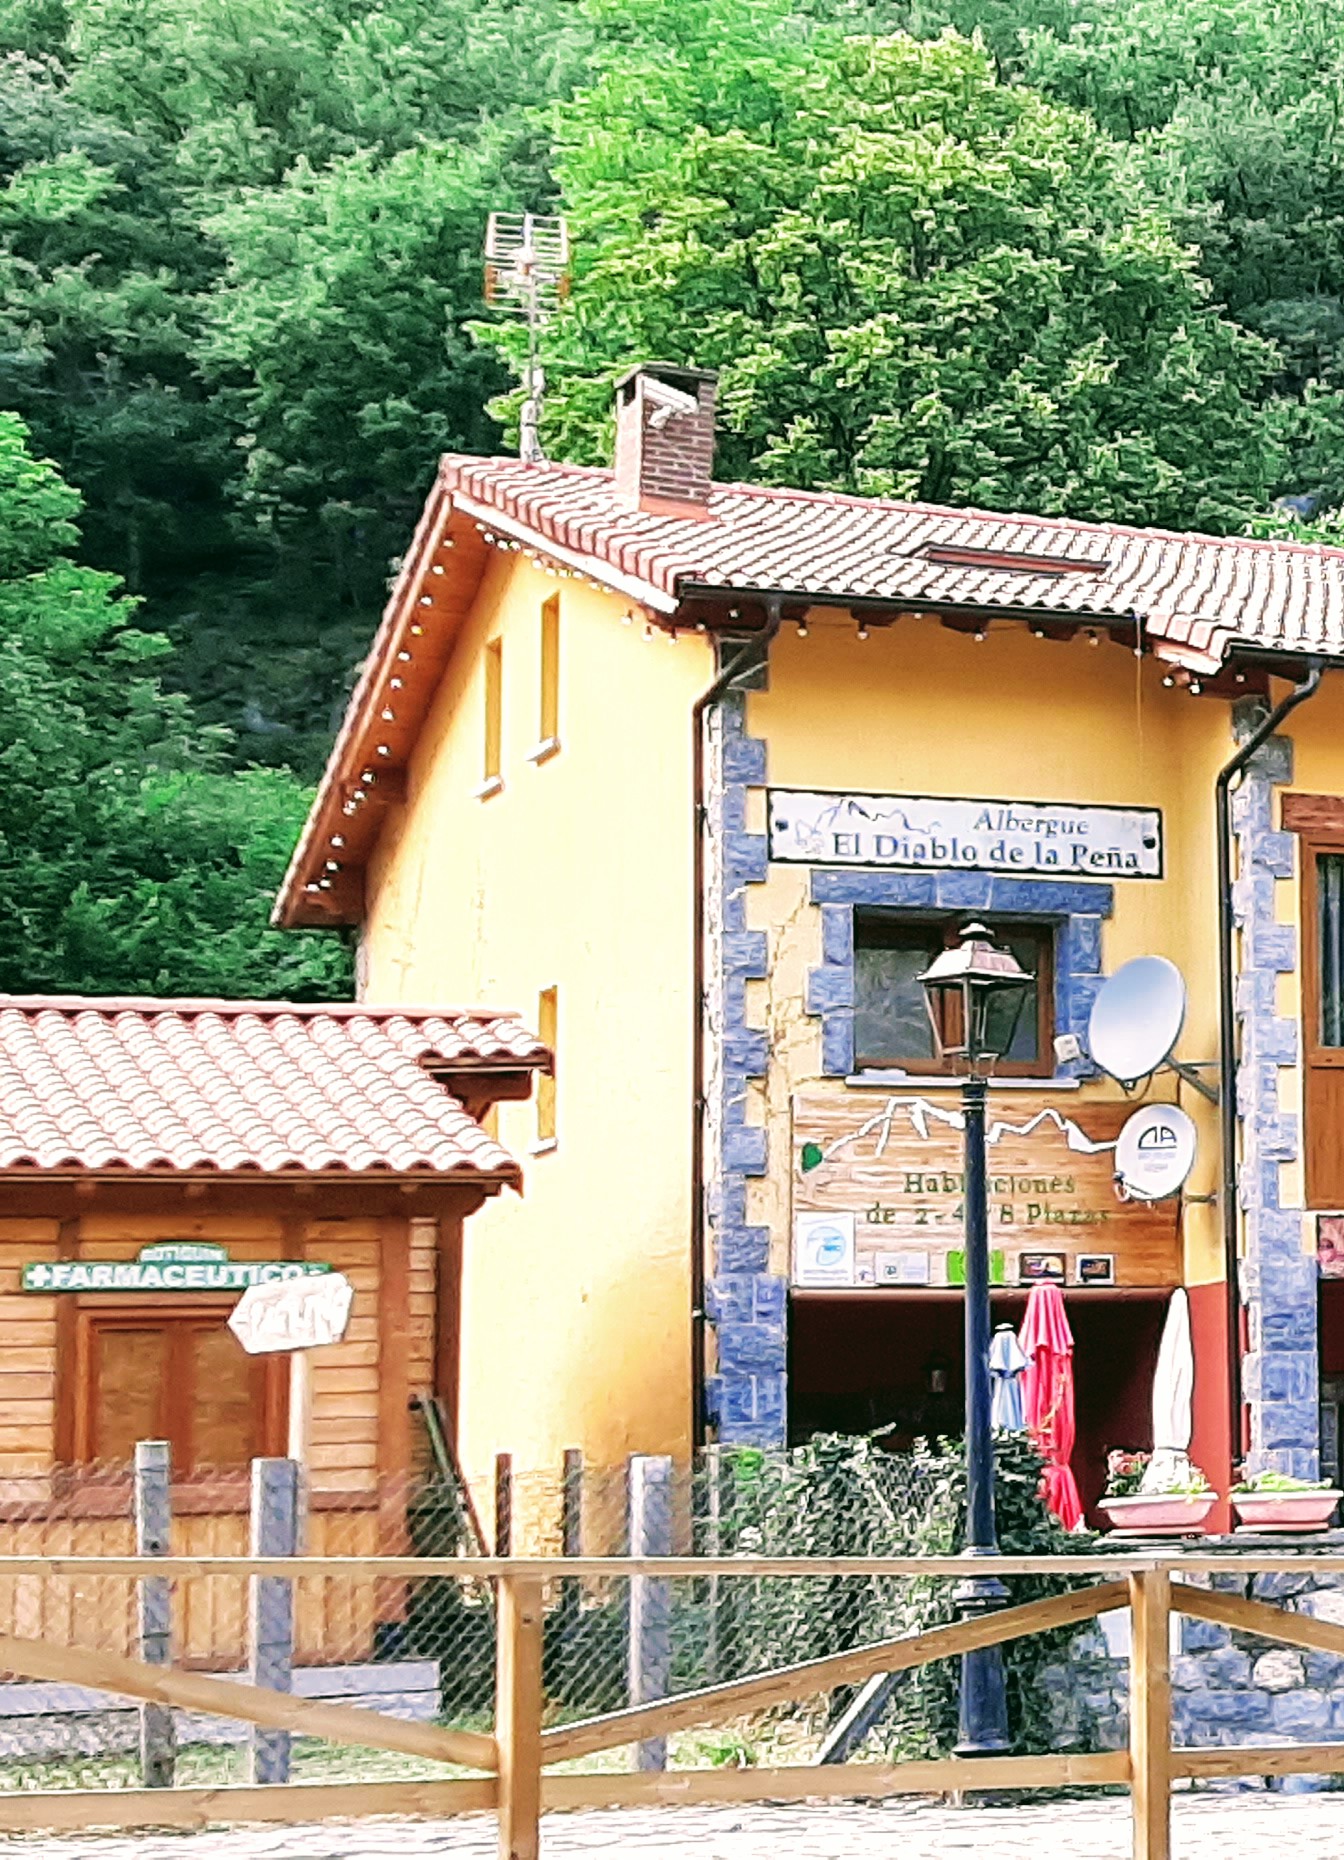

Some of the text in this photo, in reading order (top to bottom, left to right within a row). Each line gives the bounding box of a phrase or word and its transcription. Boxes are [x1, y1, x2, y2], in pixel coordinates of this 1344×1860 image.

[973, 809, 1089, 836] Albergue
[833, 833, 1140, 870] El Diablo de la Peña
[903, 1171, 1076, 1194] Habiciones
[866, 1202, 896, 1225] de
[51, 1264, 303, 1288] FARMACEUTICO
